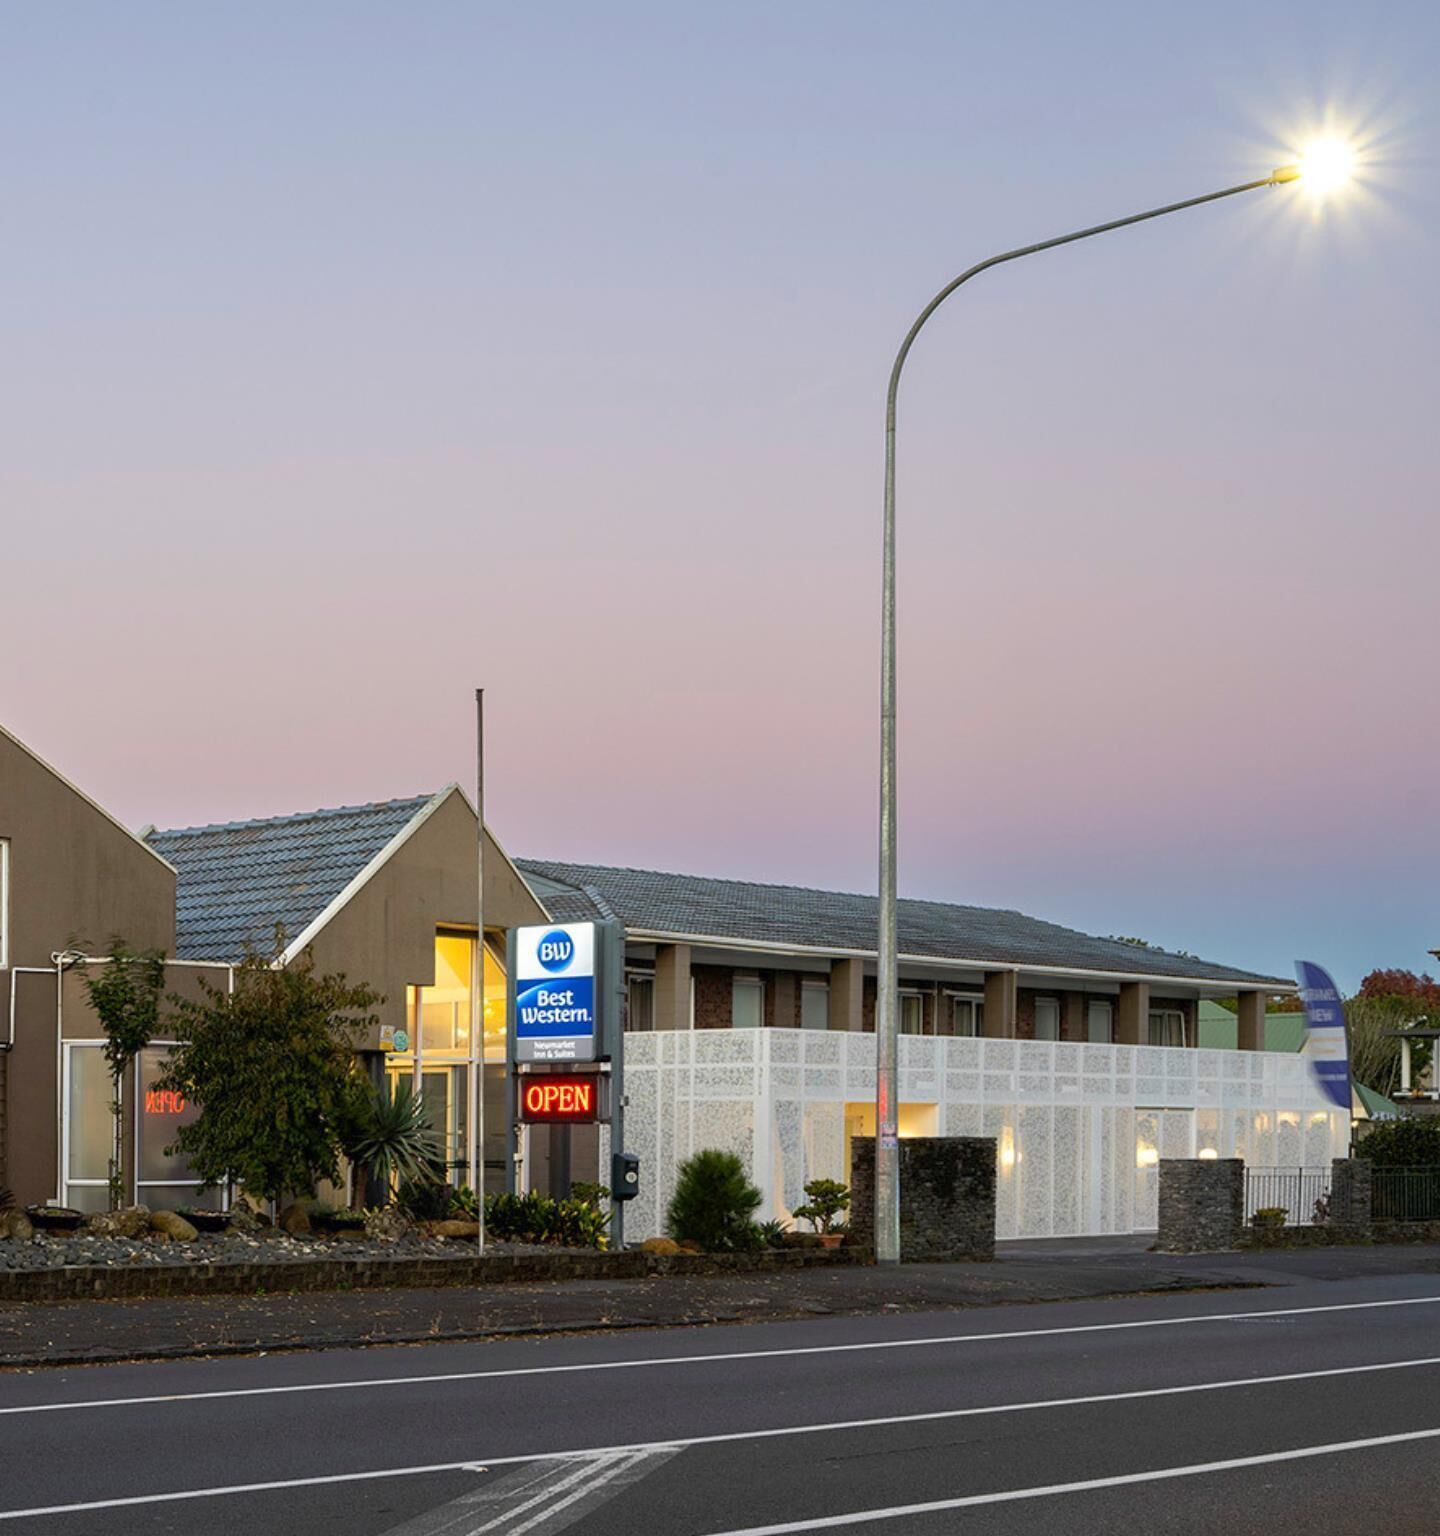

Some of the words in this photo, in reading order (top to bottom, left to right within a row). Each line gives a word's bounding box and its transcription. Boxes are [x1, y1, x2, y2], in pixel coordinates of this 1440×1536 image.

[541, 942, 571, 962] BW
[537, 990, 574, 1006] Best
[533, 1040, 576, 1050] Newmarket
[527, 1086, 591, 1111] OPEN
